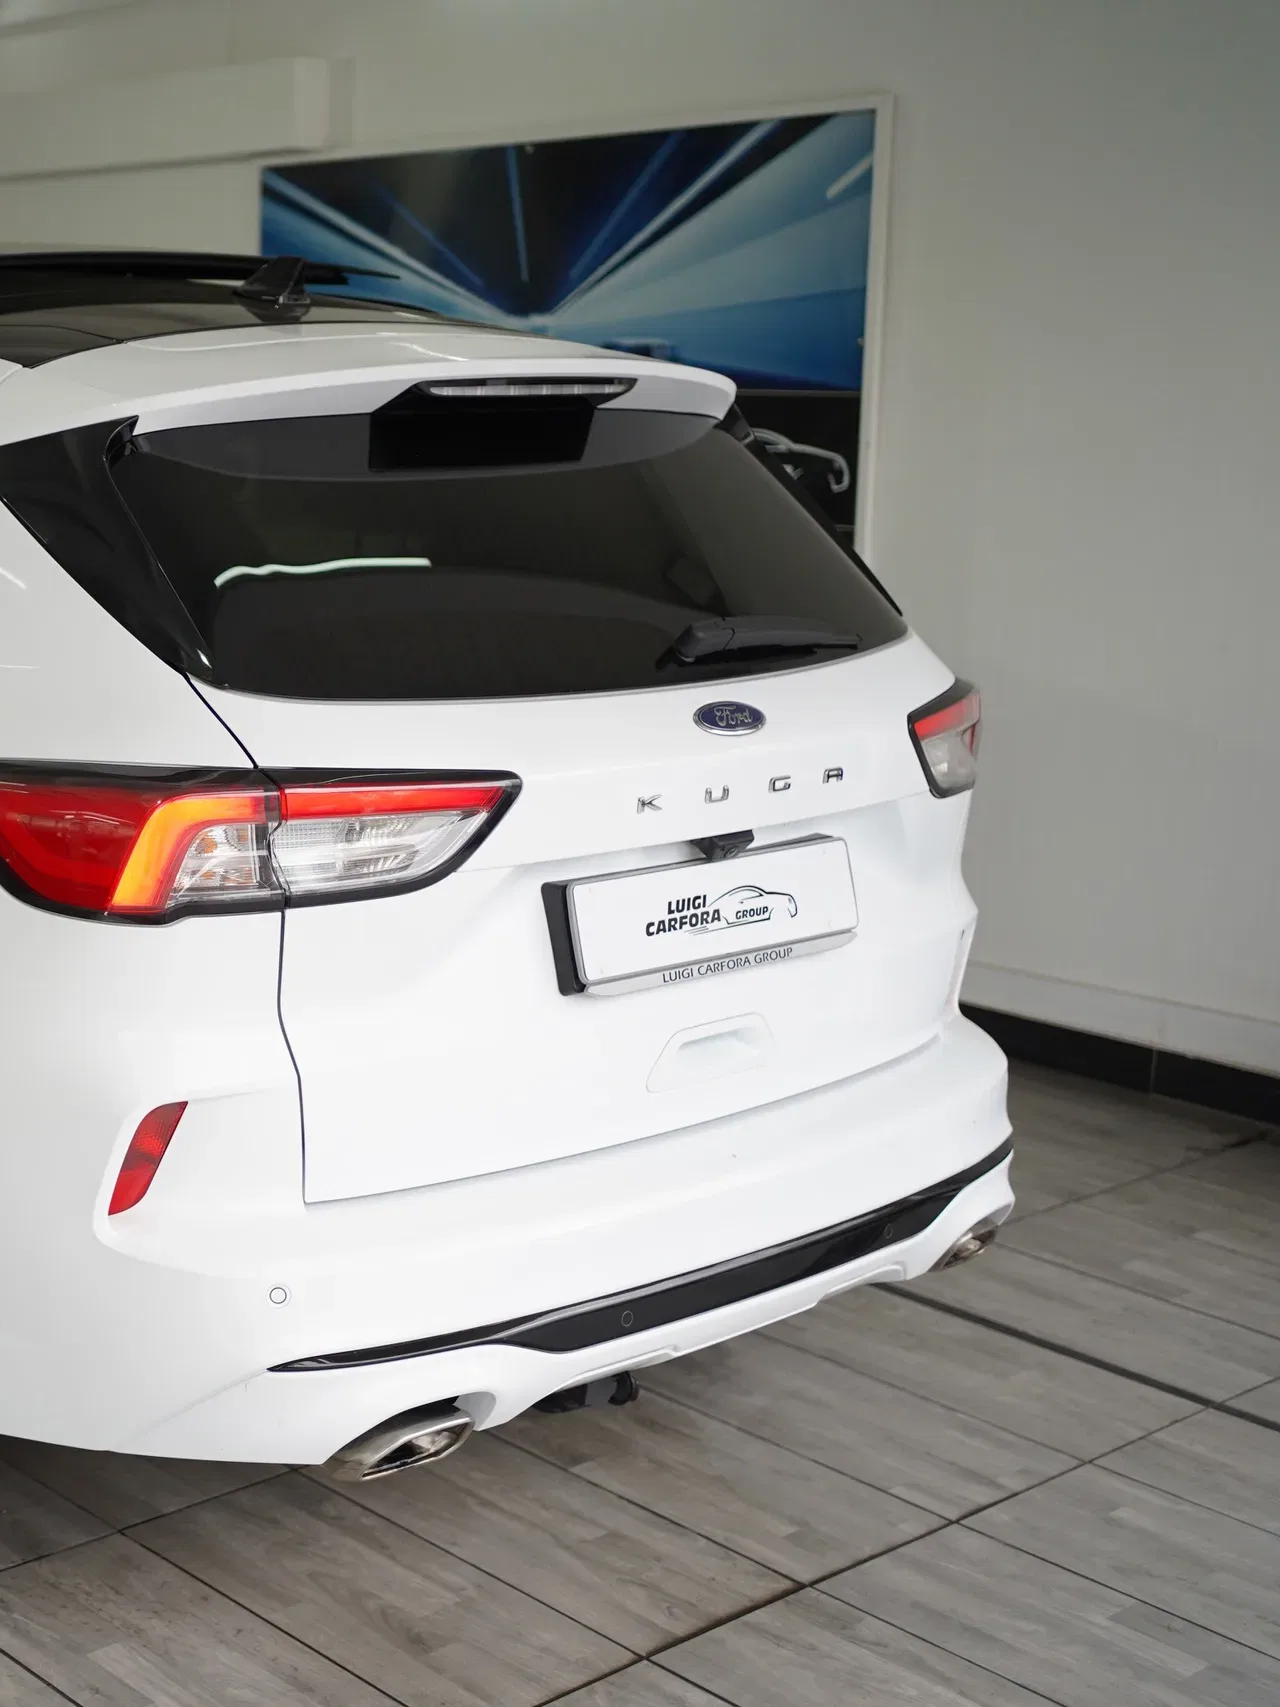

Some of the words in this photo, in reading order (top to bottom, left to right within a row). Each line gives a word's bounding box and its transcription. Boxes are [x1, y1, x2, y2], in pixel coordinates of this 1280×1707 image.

[714, 705, 753, 726] Ford
[637, 767, 843, 813] KUGA
[667, 894, 707, 915] LUIGI
[735, 905, 769, 920] GROUP
[645, 908, 721, 937] CARFORA
[662, 967, 694, 983] LUIGI
[697, 956, 751, 975] CARFORA
[754, 947, 793, 964] GROUP
